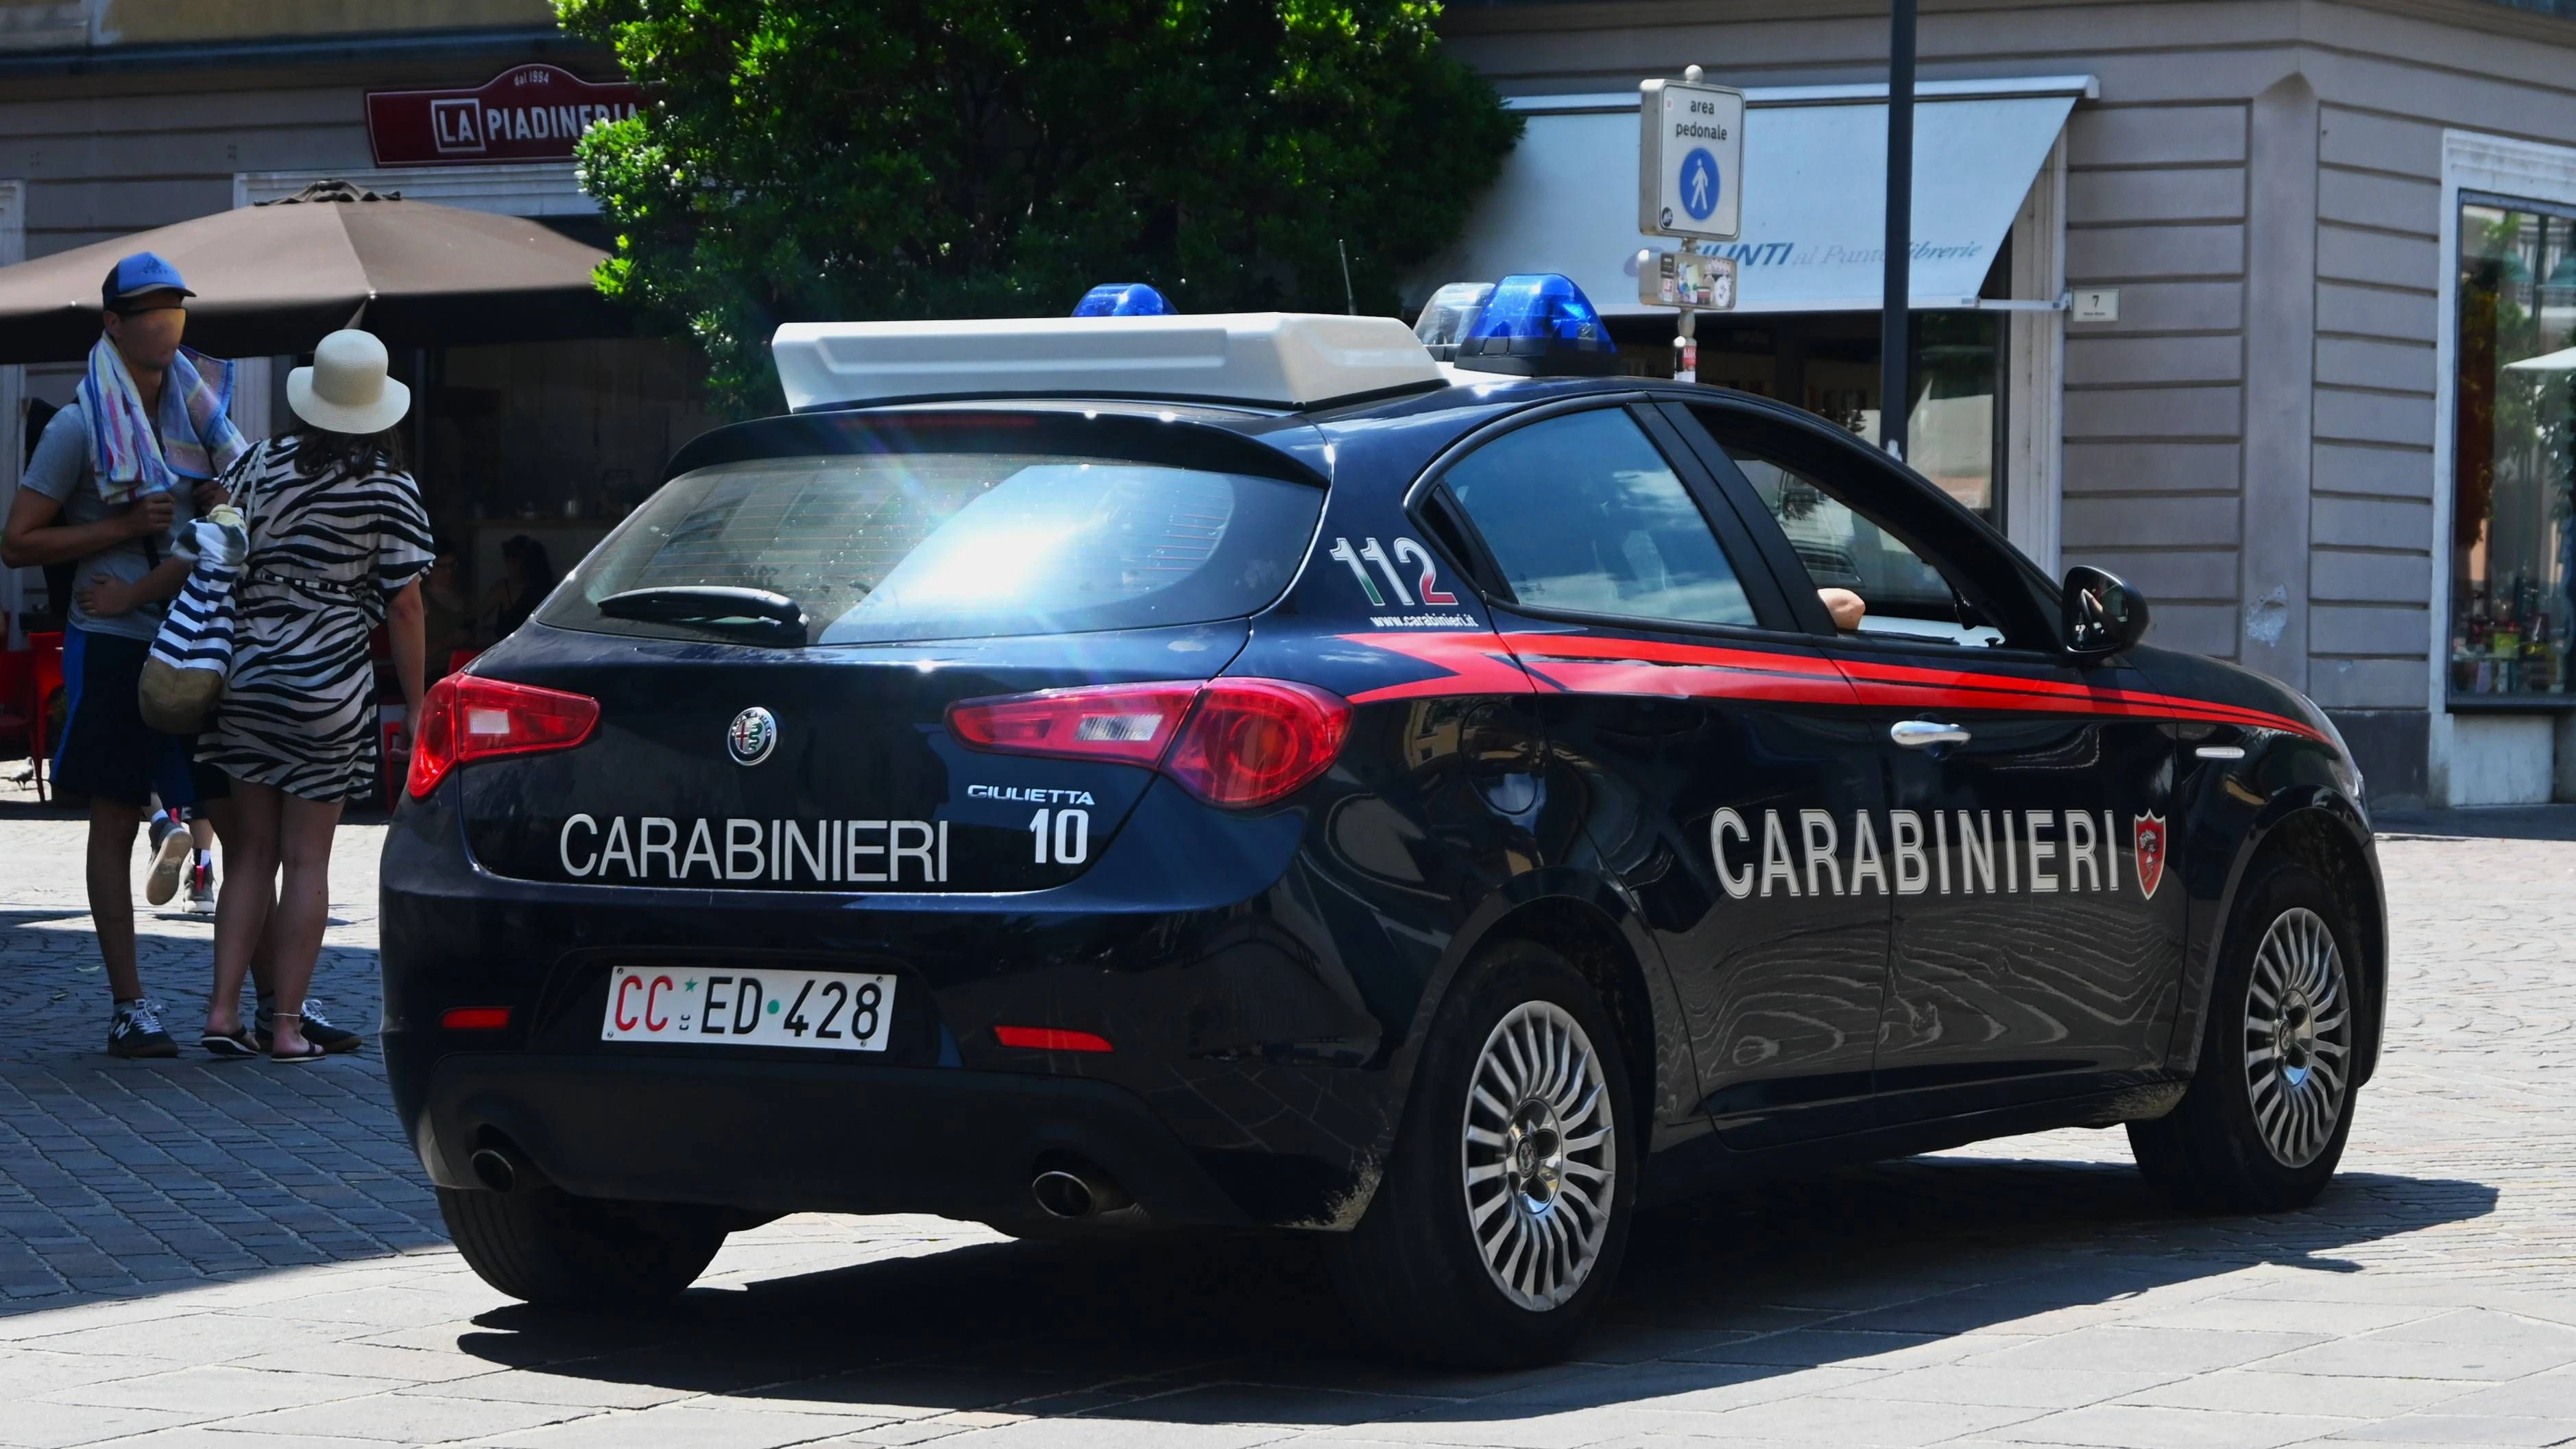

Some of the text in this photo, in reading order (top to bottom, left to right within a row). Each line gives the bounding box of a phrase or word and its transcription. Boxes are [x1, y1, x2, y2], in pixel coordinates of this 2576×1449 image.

[1690, 100, 1715, 115] area
[439, 109, 475, 142] LA
[1676, 121, 1728, 141] pedonale
[1820, 244, 1885, 265] Punt
[1910, 241, 1983, 260] ibrerie
[2092, 295, 2100, 309] 7
[1329, 537, 1459, 606] 112
[1370, 613, 1479, 627] www.carabinieri.it
[967, 785, 1095, 806] GIULIETTA
[559, 813, 948, 883] CARABINIERI
[1029, 809, 1089, 864] 10
[1710, 806, 2119, 899] CARABINIERI
[615, 975, 882, 1040] CC ED 428
